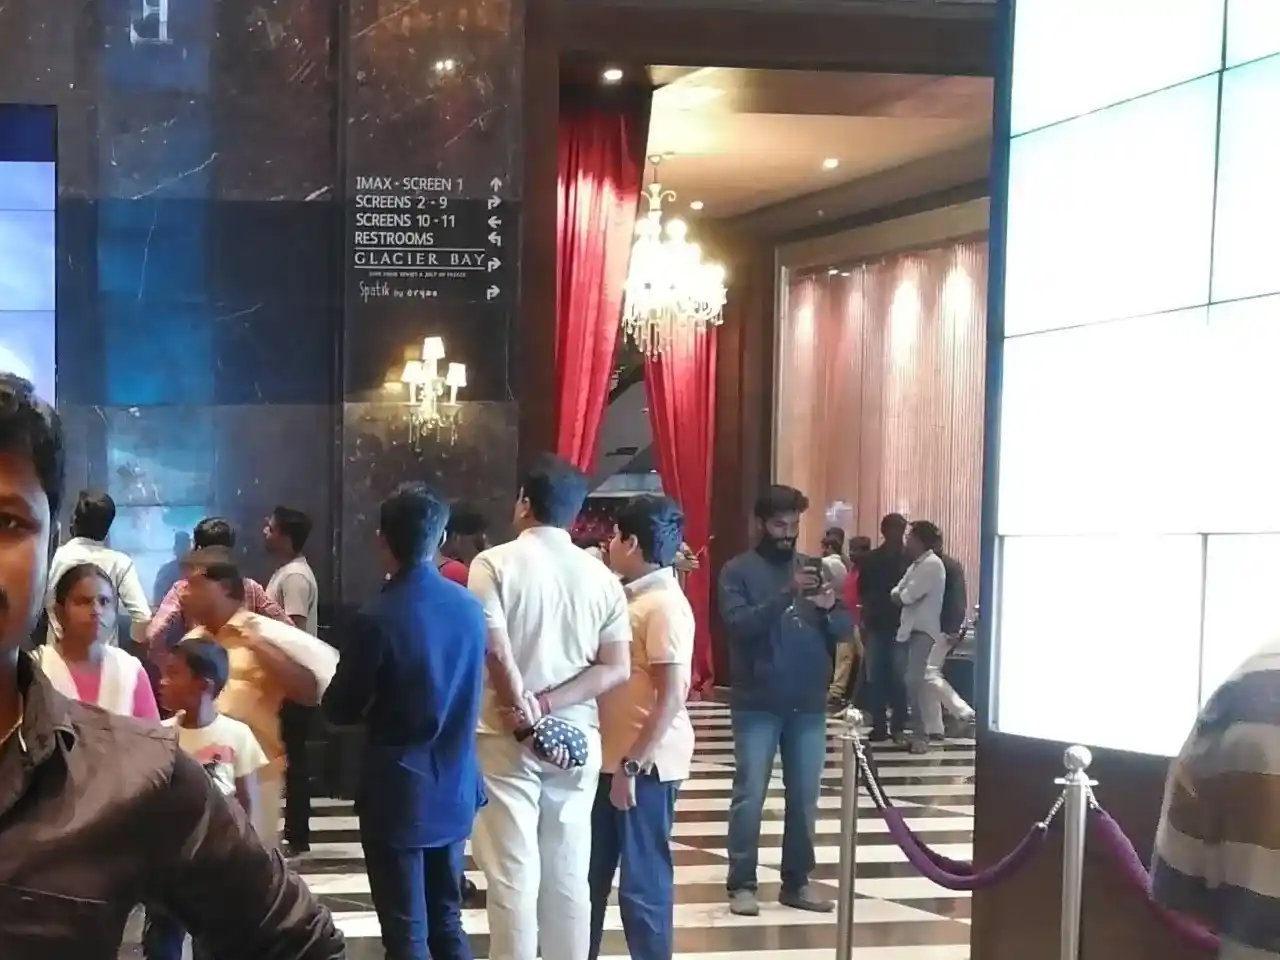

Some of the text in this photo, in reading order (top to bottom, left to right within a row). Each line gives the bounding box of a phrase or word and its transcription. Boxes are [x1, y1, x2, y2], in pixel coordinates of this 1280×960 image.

[355, 176, 392, 190] IMAX
[403, 177, 452, 191] SCREEN
[456, 178, 463, 191] 1
[355, 194, 411, 208] SCREENS
[417, 196, 426, 209] 2
[439, 196, 448, 209] 9
[355, 213, 411, 227] SCREENS
[416, 214, 431, 227] 10
[441, 215, 455, 228] 11
[355, 231, 434, 245] RESTROOMS
[354, 252, 485, 266] GLACIER BAY
